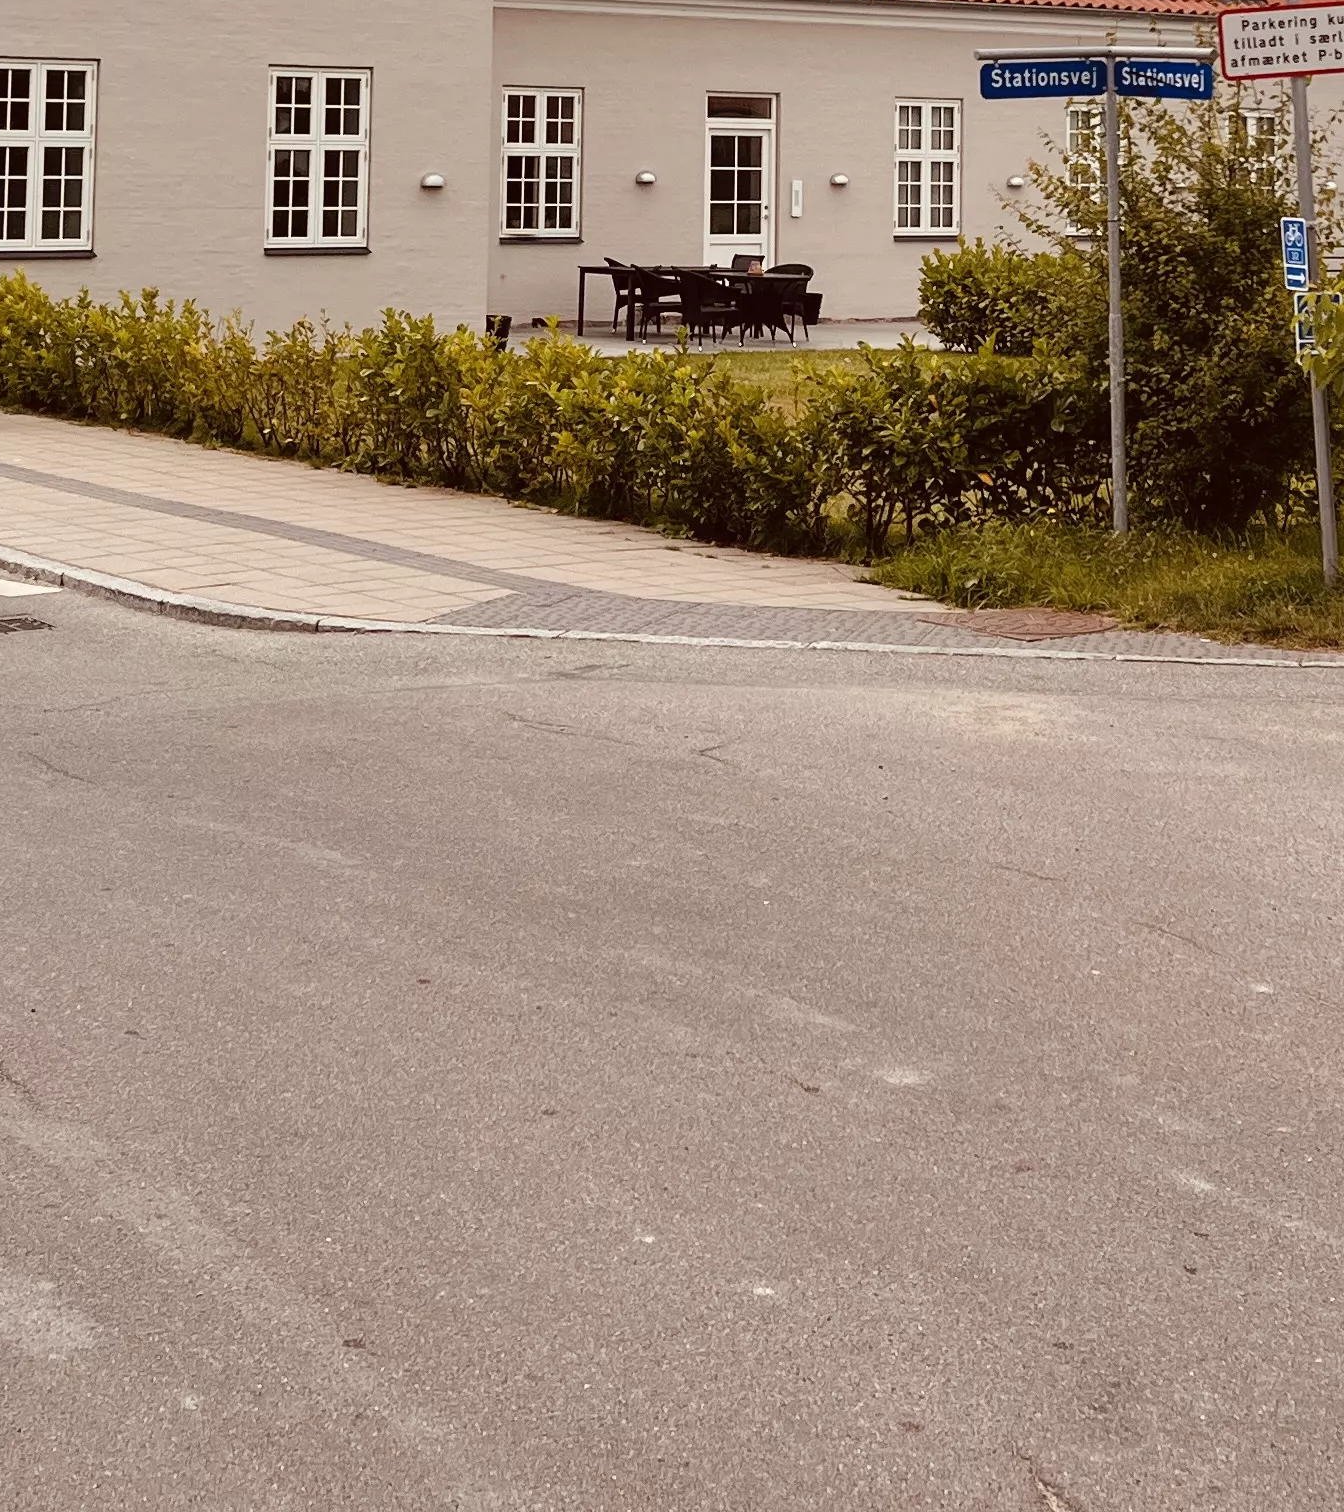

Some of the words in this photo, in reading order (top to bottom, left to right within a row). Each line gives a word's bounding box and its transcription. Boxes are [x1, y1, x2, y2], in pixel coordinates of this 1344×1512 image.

[1241, 16, 1318, 32] Parkering
[1233, 35, 1285, 50] tilladt
[1294, 33, 1299, 45] i
[1230, 51, 1308, 68] afmærket
[991, 66, 1097, 88] Stationsvej
[1121, 66, 1205, 92] Stationsvej
